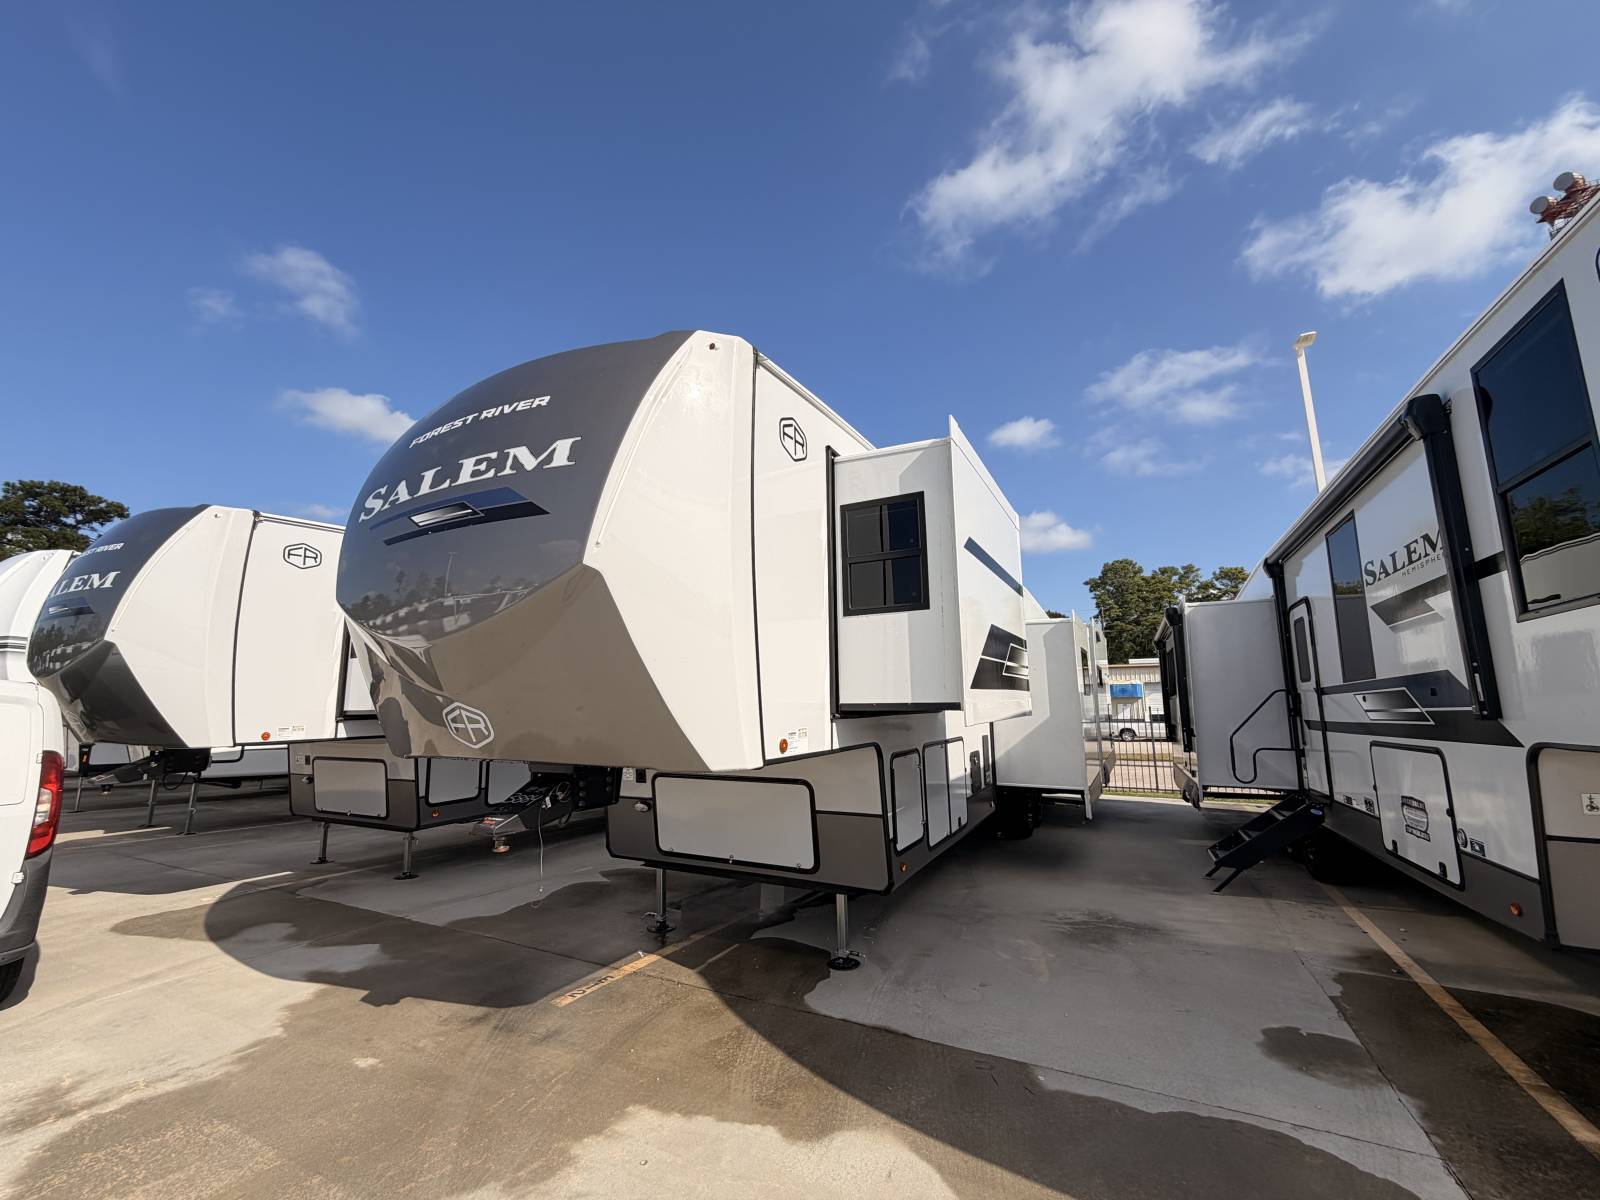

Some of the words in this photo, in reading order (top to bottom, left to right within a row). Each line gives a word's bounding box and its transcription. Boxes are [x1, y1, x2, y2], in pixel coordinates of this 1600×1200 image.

[409, 412, 479, 449] FOREST
[479, 395, 551, 421] RIVER
[358, 436, 582, 523] SALEM
[1401, 553, 1441, 577] HEMISPHE
